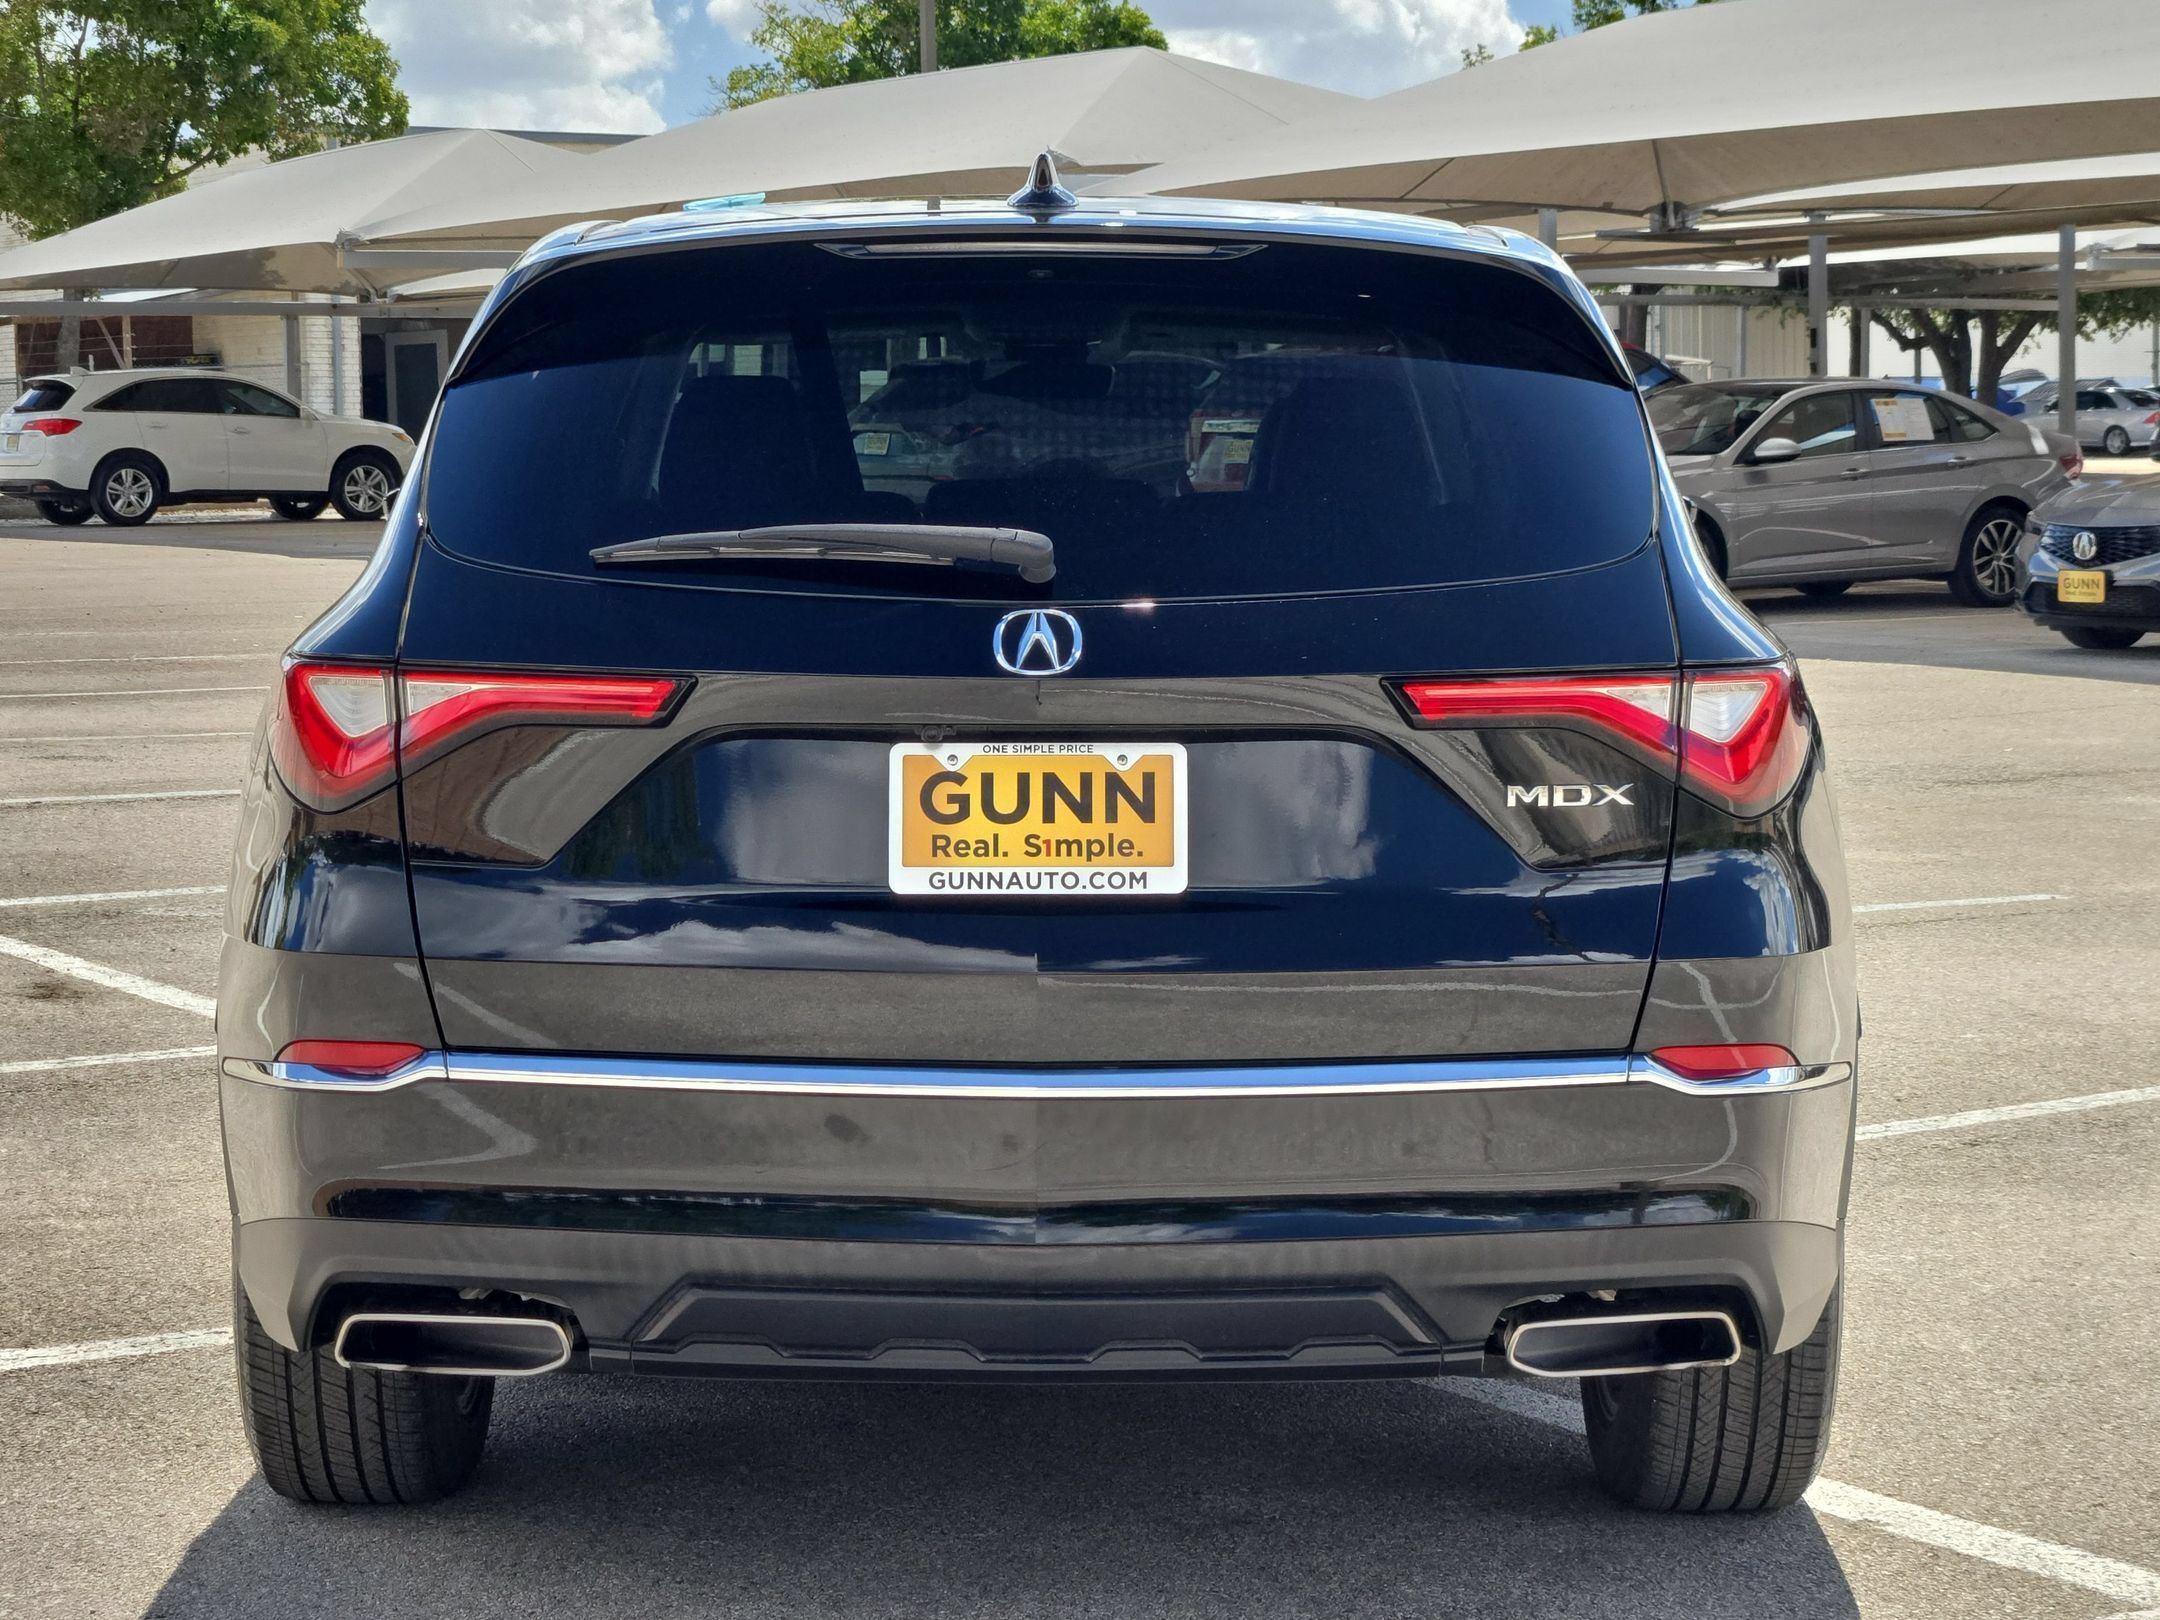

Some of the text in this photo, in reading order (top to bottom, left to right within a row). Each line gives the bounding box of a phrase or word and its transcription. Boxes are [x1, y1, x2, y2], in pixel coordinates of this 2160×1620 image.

[2063, 577, 2100, 590] GUNN
[983, 744, 1094, 754] ONE SIMPLE PRICE
[919, 771, 1156, 825] GUNN
[1506, 783, 1635, 807] MDX
[931, 833, 1009, 858] Real.
[928, 871, 1148, 890] GUNNAUTO.COM
